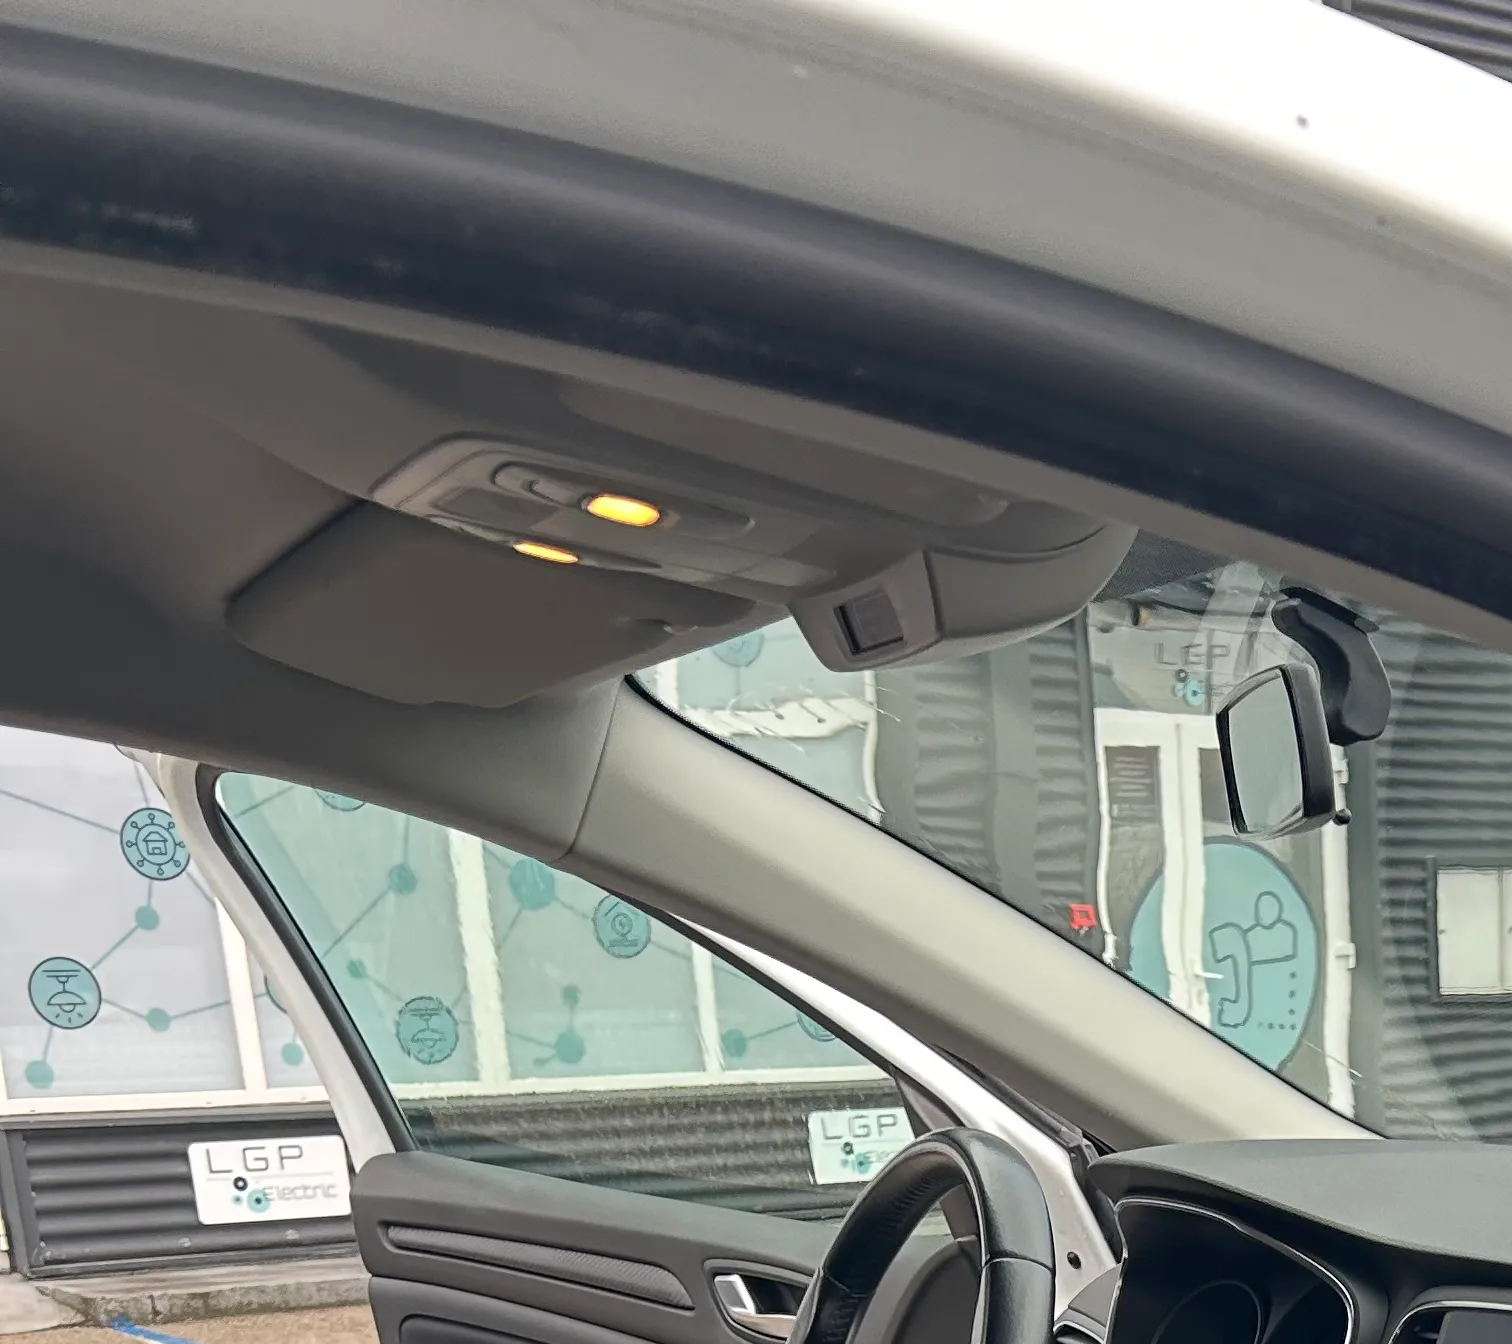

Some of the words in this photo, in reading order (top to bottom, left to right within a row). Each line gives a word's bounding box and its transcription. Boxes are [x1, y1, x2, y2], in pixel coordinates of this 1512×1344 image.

[820, 1113, 898, 1140] LGP
[205, 1144, 303, 1174] LGP
[263, 1183, 338, 1202] Electric
